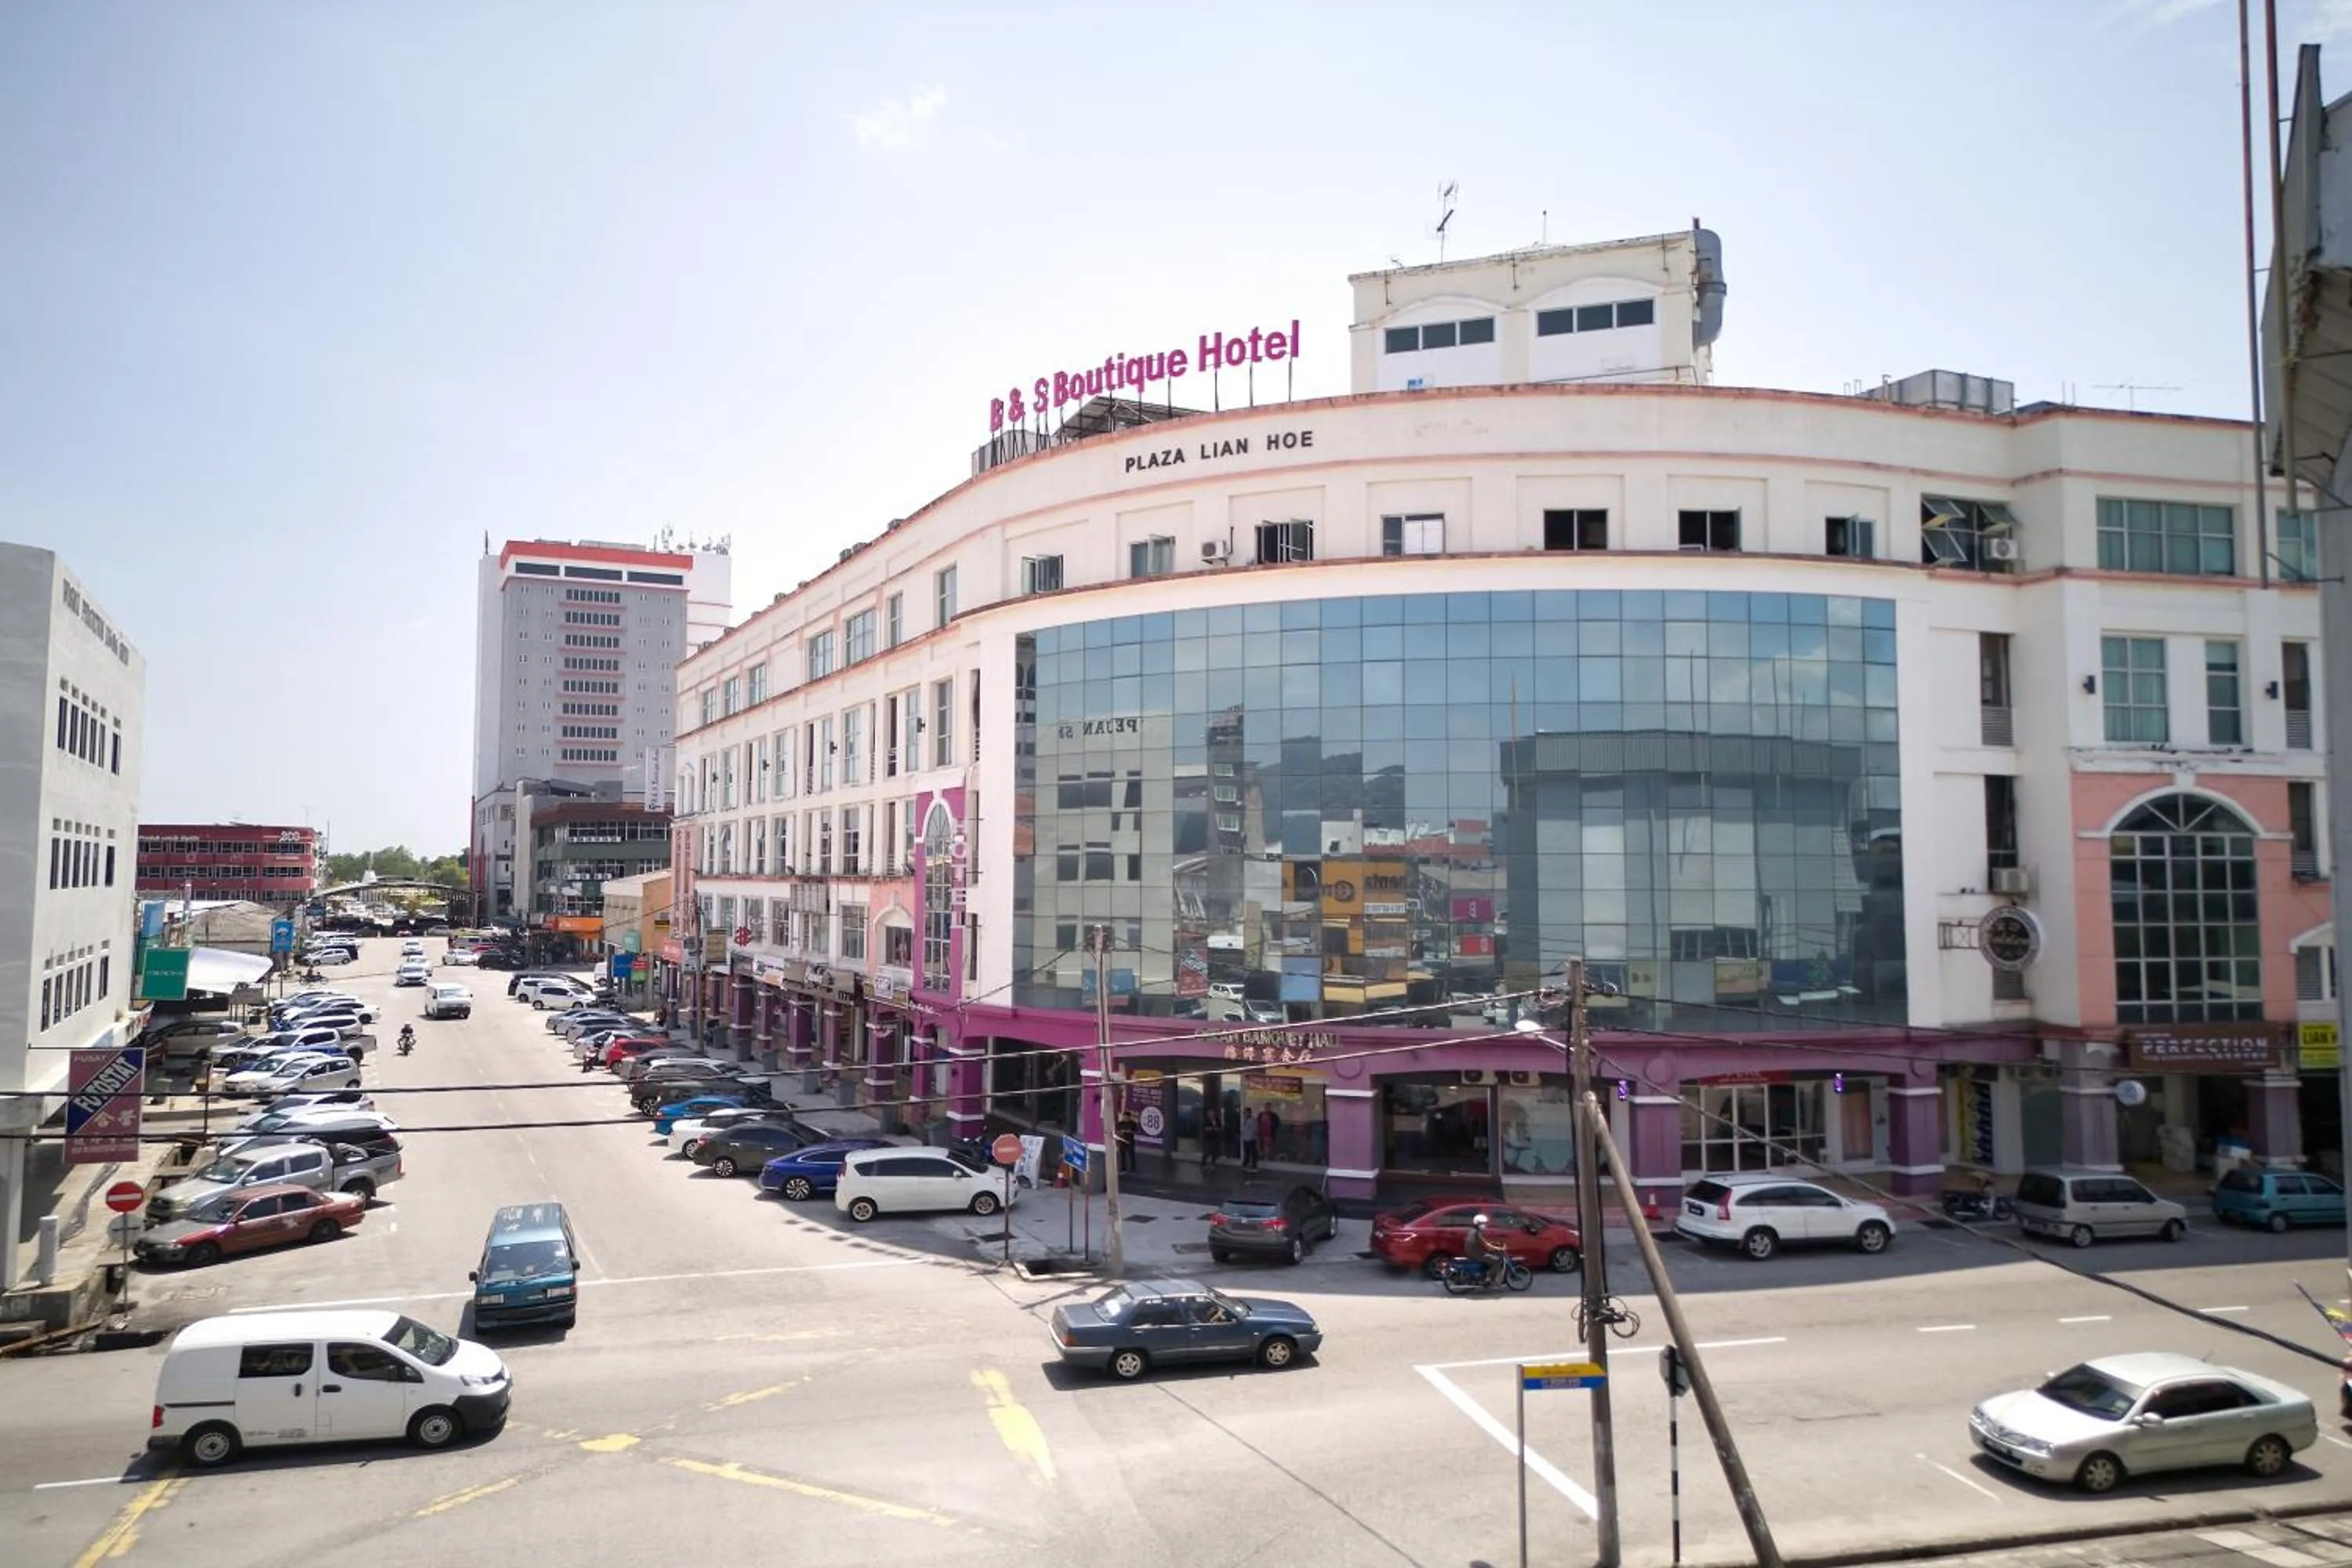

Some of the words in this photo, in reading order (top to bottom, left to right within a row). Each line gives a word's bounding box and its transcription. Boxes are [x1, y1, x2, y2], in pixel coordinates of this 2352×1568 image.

[989, 397, 1004, 432] B
[1008, 388, 1025, 422] &
[1033, 378, 1049, 413] S
[1053, 348, 1188, 408] Boutique
[1198, 320, 1300, 372] Hotel
[1126, 448, 1185, 473] PLAZA
[1200, 437, 1249, 459] LIAN
[1266, 430, 1314, 451] HOE
[2142, 1038, 2268, 1054] PERFECTION
